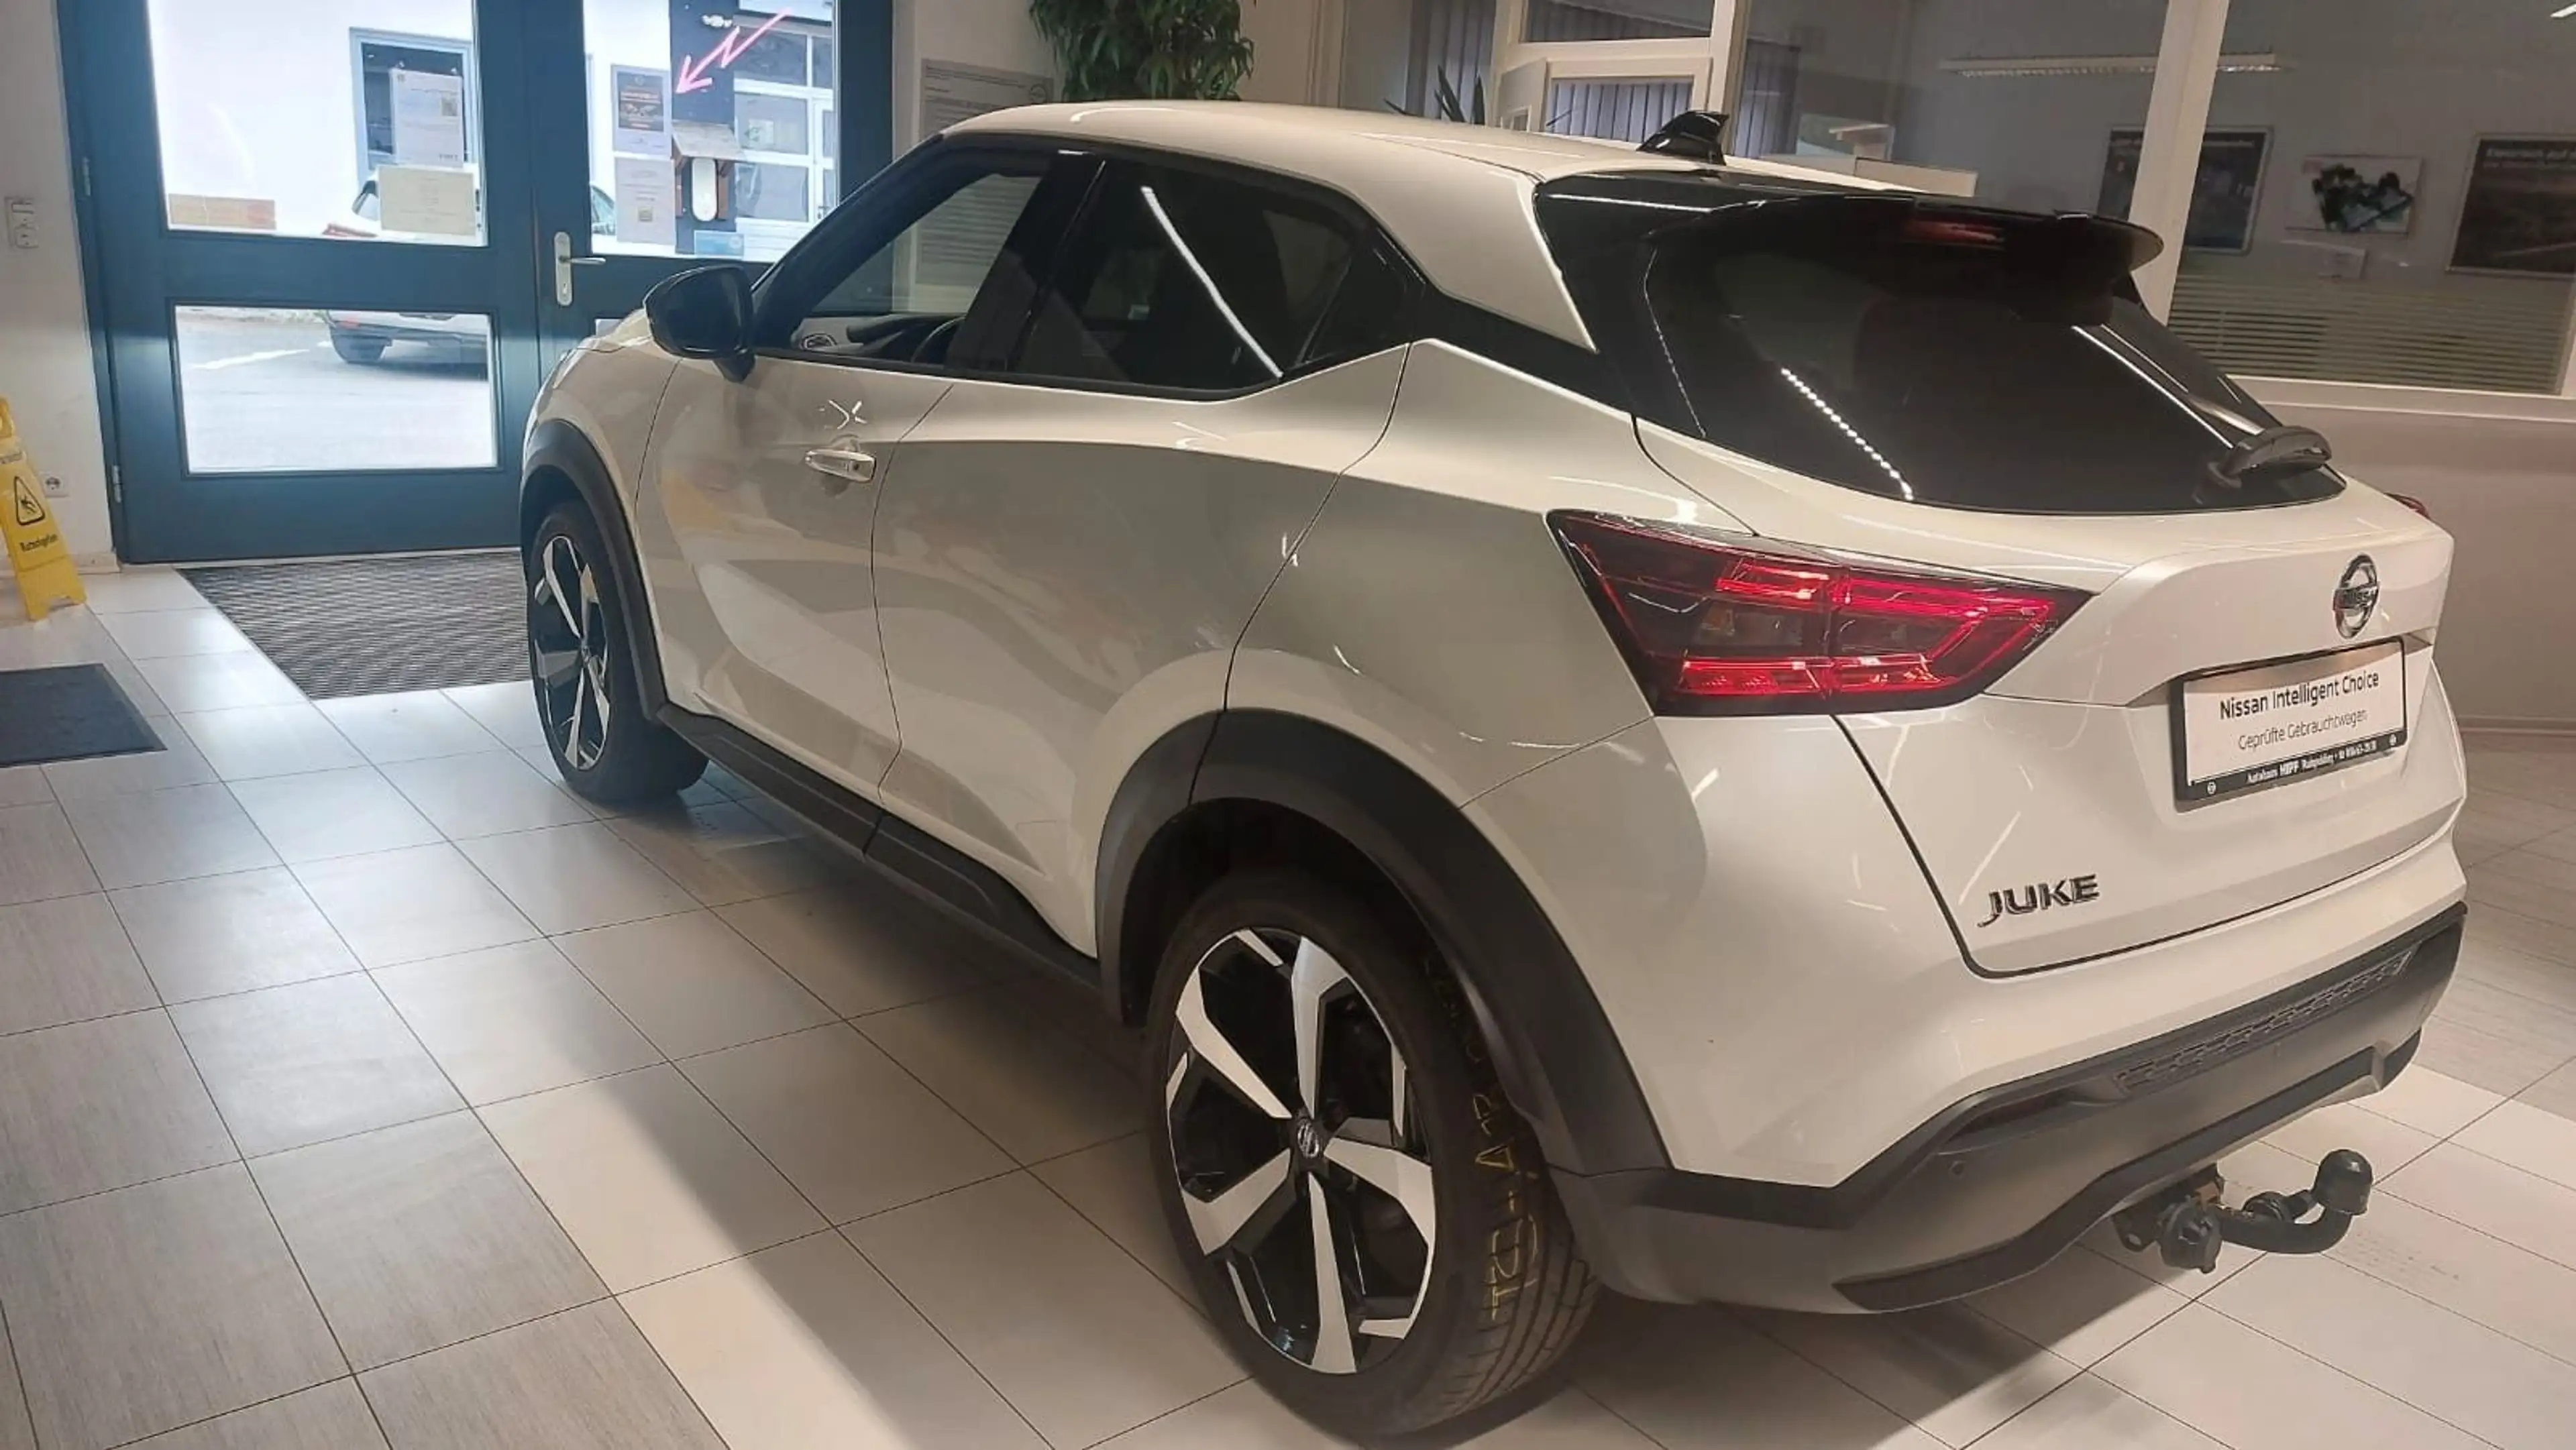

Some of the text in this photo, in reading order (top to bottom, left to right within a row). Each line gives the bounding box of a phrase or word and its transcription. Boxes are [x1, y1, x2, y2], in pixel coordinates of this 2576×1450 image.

[2220, 671, 2379, 720] Nissan Intelligent Choice
[2238, 710, 2367, 751] Geprüfte Gebrauchtwagen
[1977, 874, 2100, 928] JUKE
